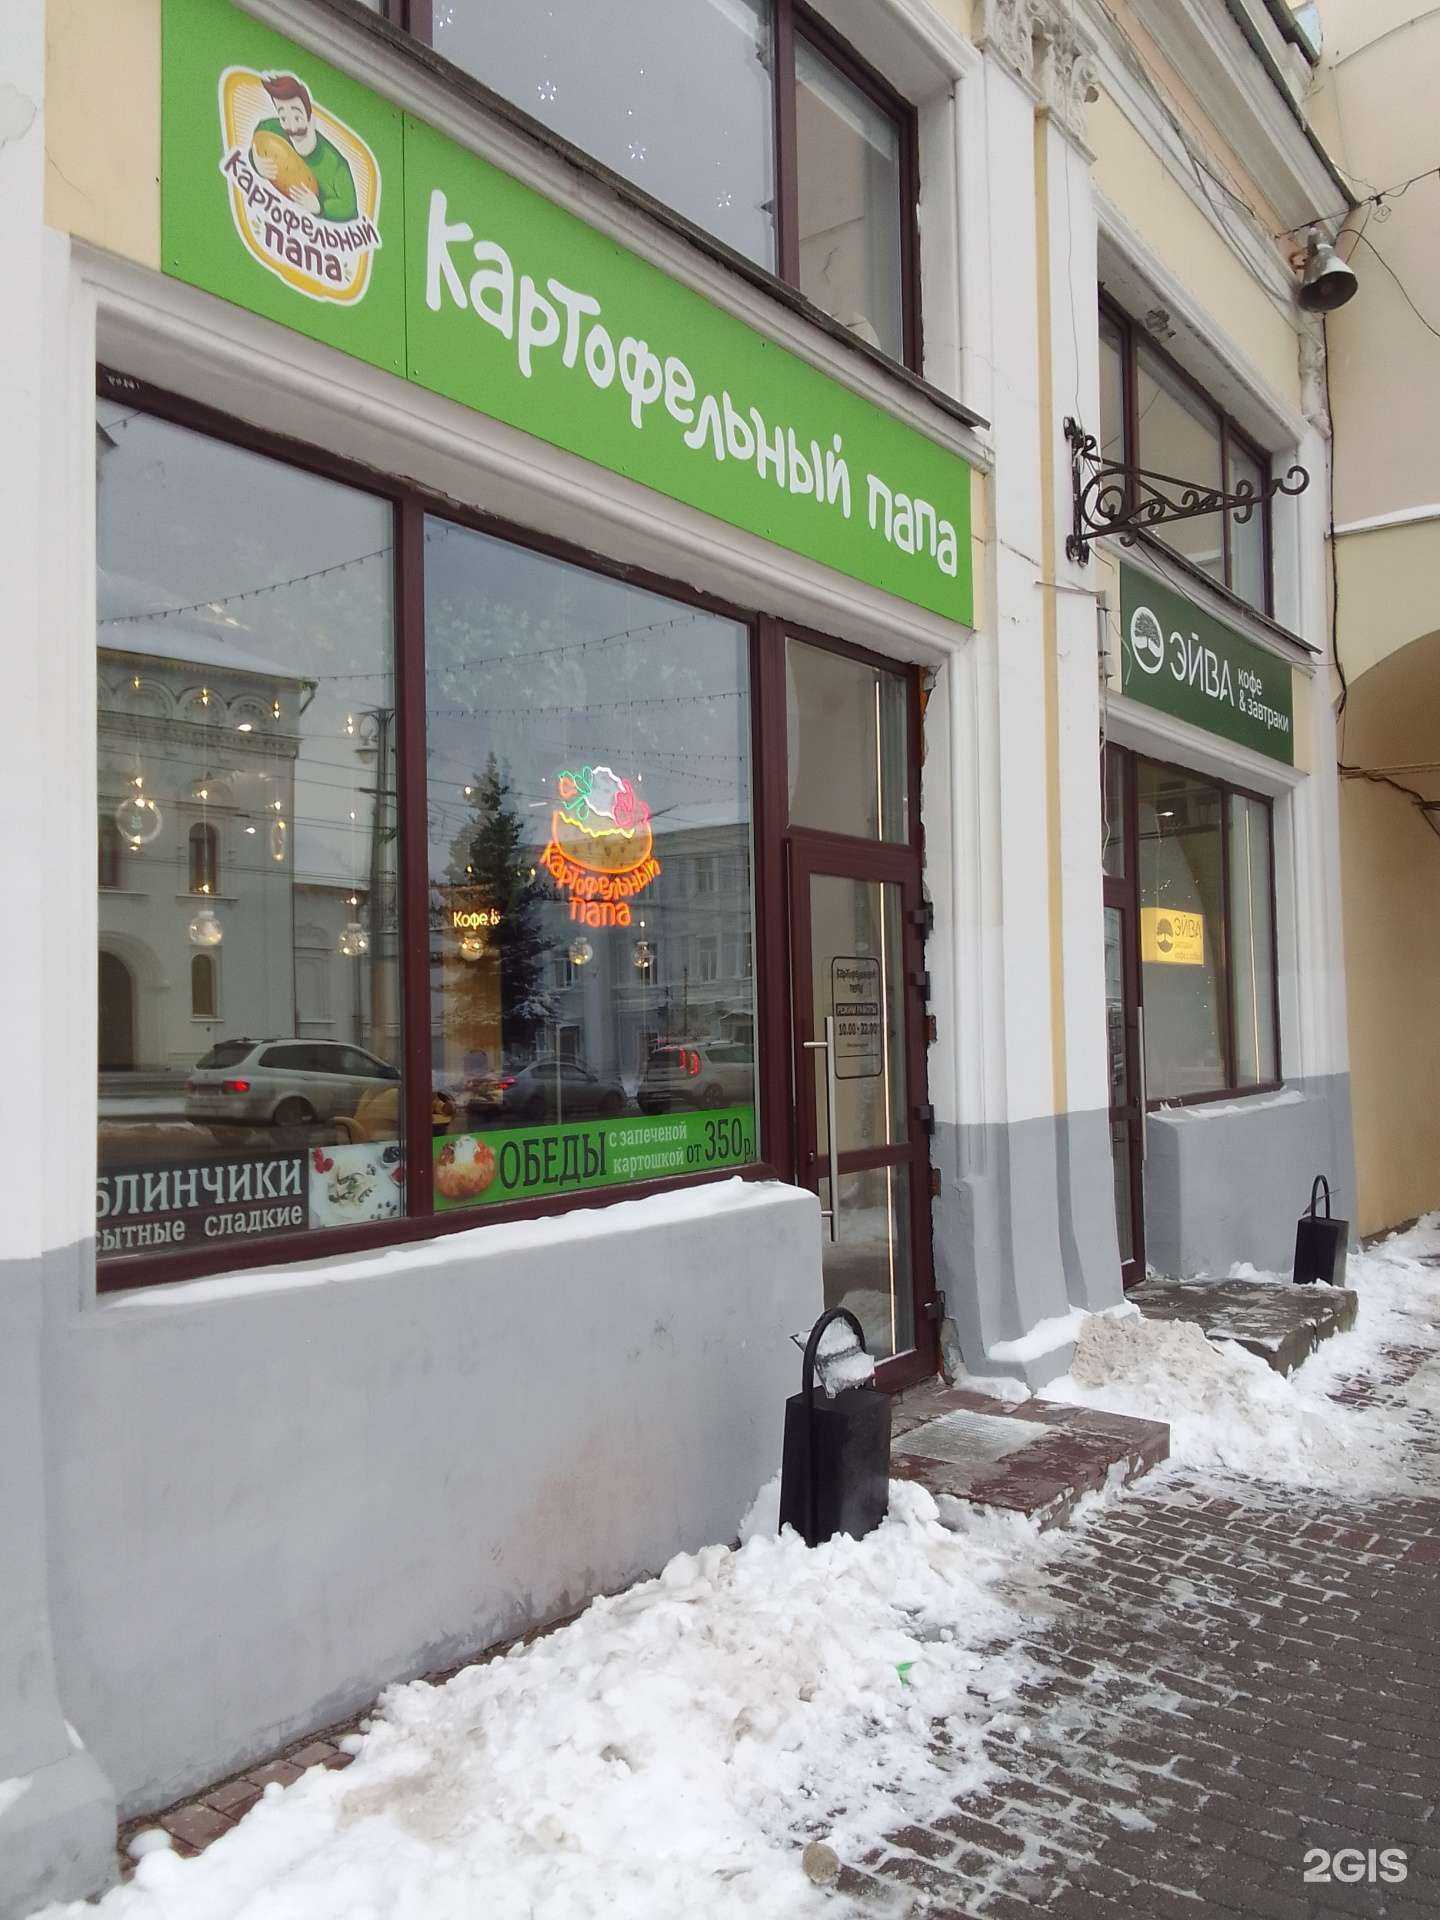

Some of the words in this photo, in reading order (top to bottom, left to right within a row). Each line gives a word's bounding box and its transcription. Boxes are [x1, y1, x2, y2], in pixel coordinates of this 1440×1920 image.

[224, 150, 379, 252] Картофельный
[264, 221, 342, 282] папа
[426, 189, 851, 519] Картофельный
[867, 473, 958, 578] папа
[1170, 632, 1234, 707] ЭЙВА
[1238, 668, 1263, 695] кофе
[1239, 689, 1247, 712] &
[1247, 698, 1289, 733] завтраки
[569, 896, 631, 928] папа
[1174, 914, 1202, 939] ЭЙВА
[609, 1132, 618, 1147] с
[620, 1122, 688, 1146] запеченой
[500, 1132, 607, 1190] ОБЕДЫ
[613, 1149, 685, 1178] картошкой
[204, 1204, 303, 1237] сладкие
